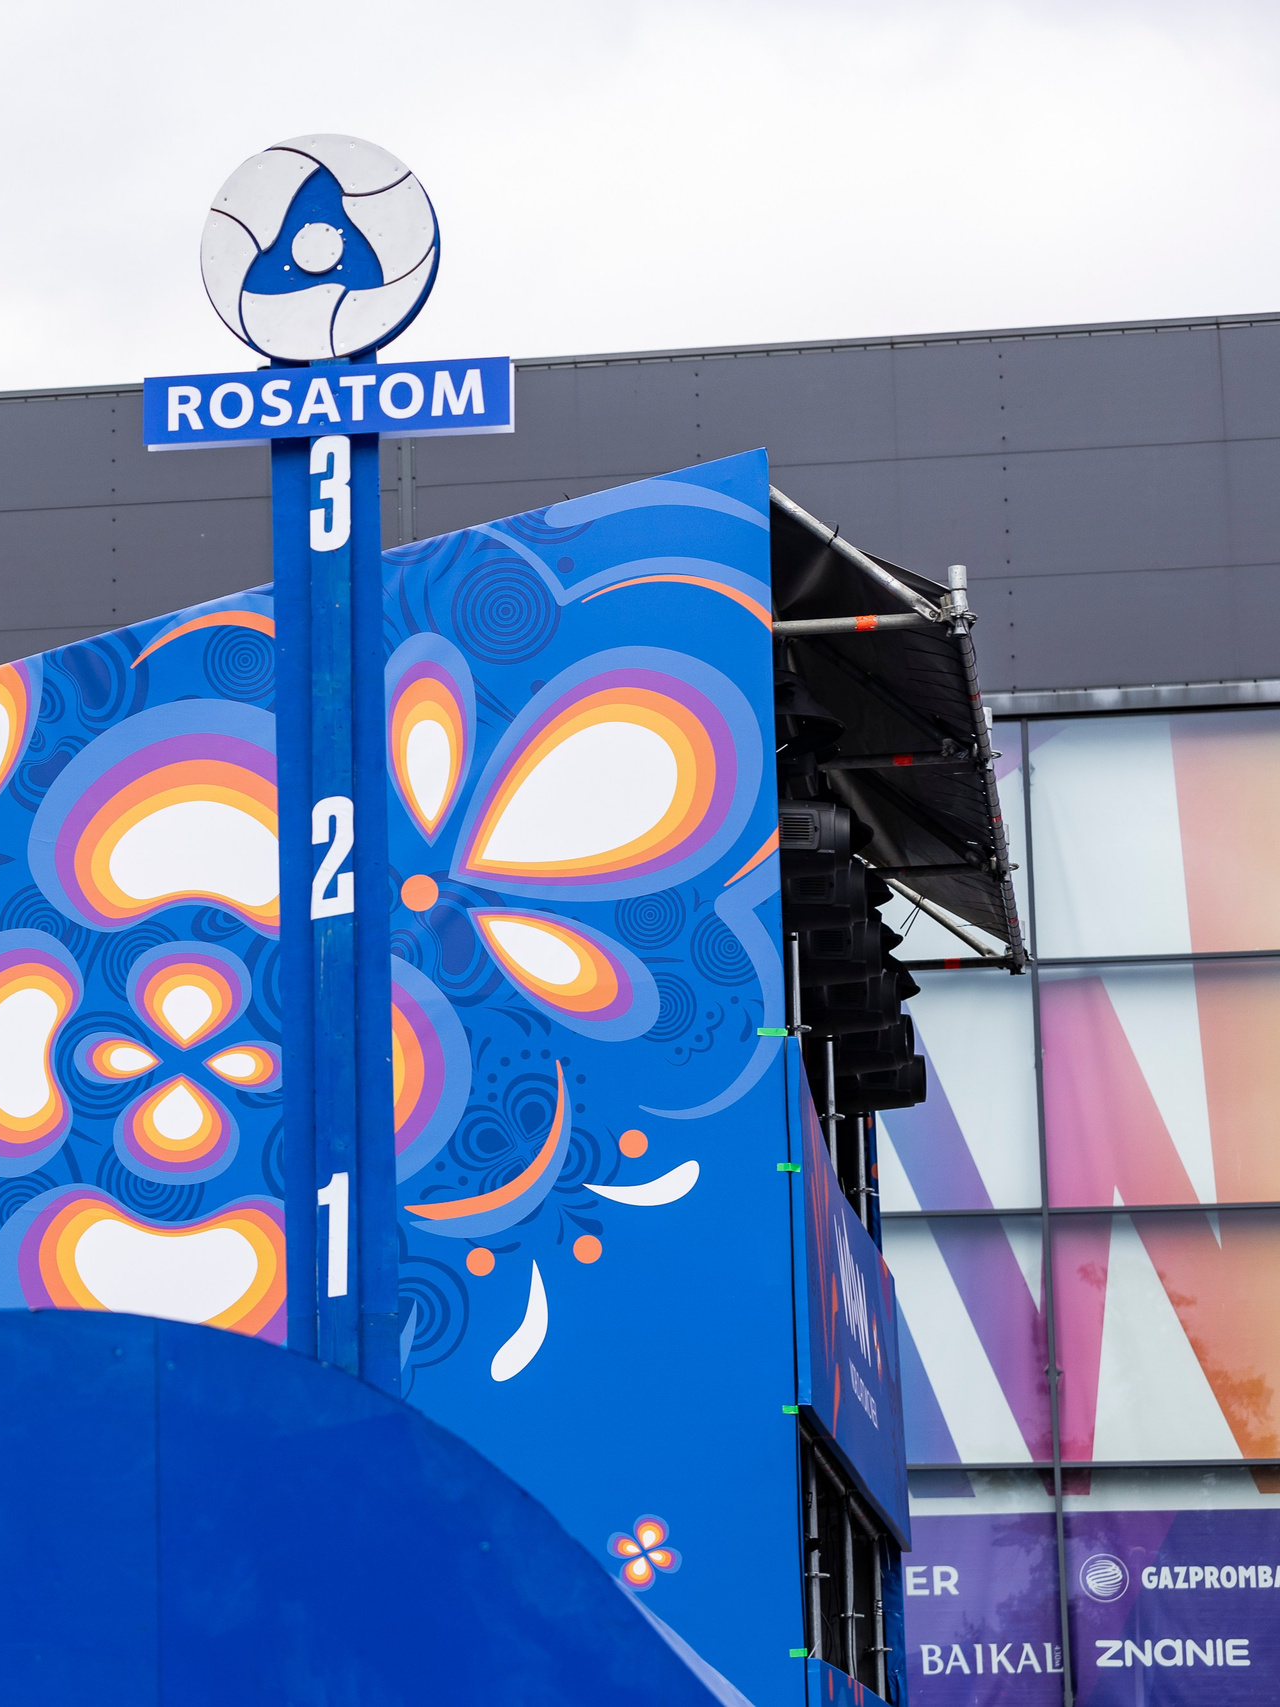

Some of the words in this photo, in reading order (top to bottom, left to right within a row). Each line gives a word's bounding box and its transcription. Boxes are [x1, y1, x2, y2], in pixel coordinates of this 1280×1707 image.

[167, 368, 485, 432] ROSATOM
[309, 434, 351, 552] 3
[310, 796, 355, 920] 2
[317, 1172, 349, 1298] 1
[905, 1565, 960, 1596] ER
[920, 1642, 1064, 1675] BAIKAL
